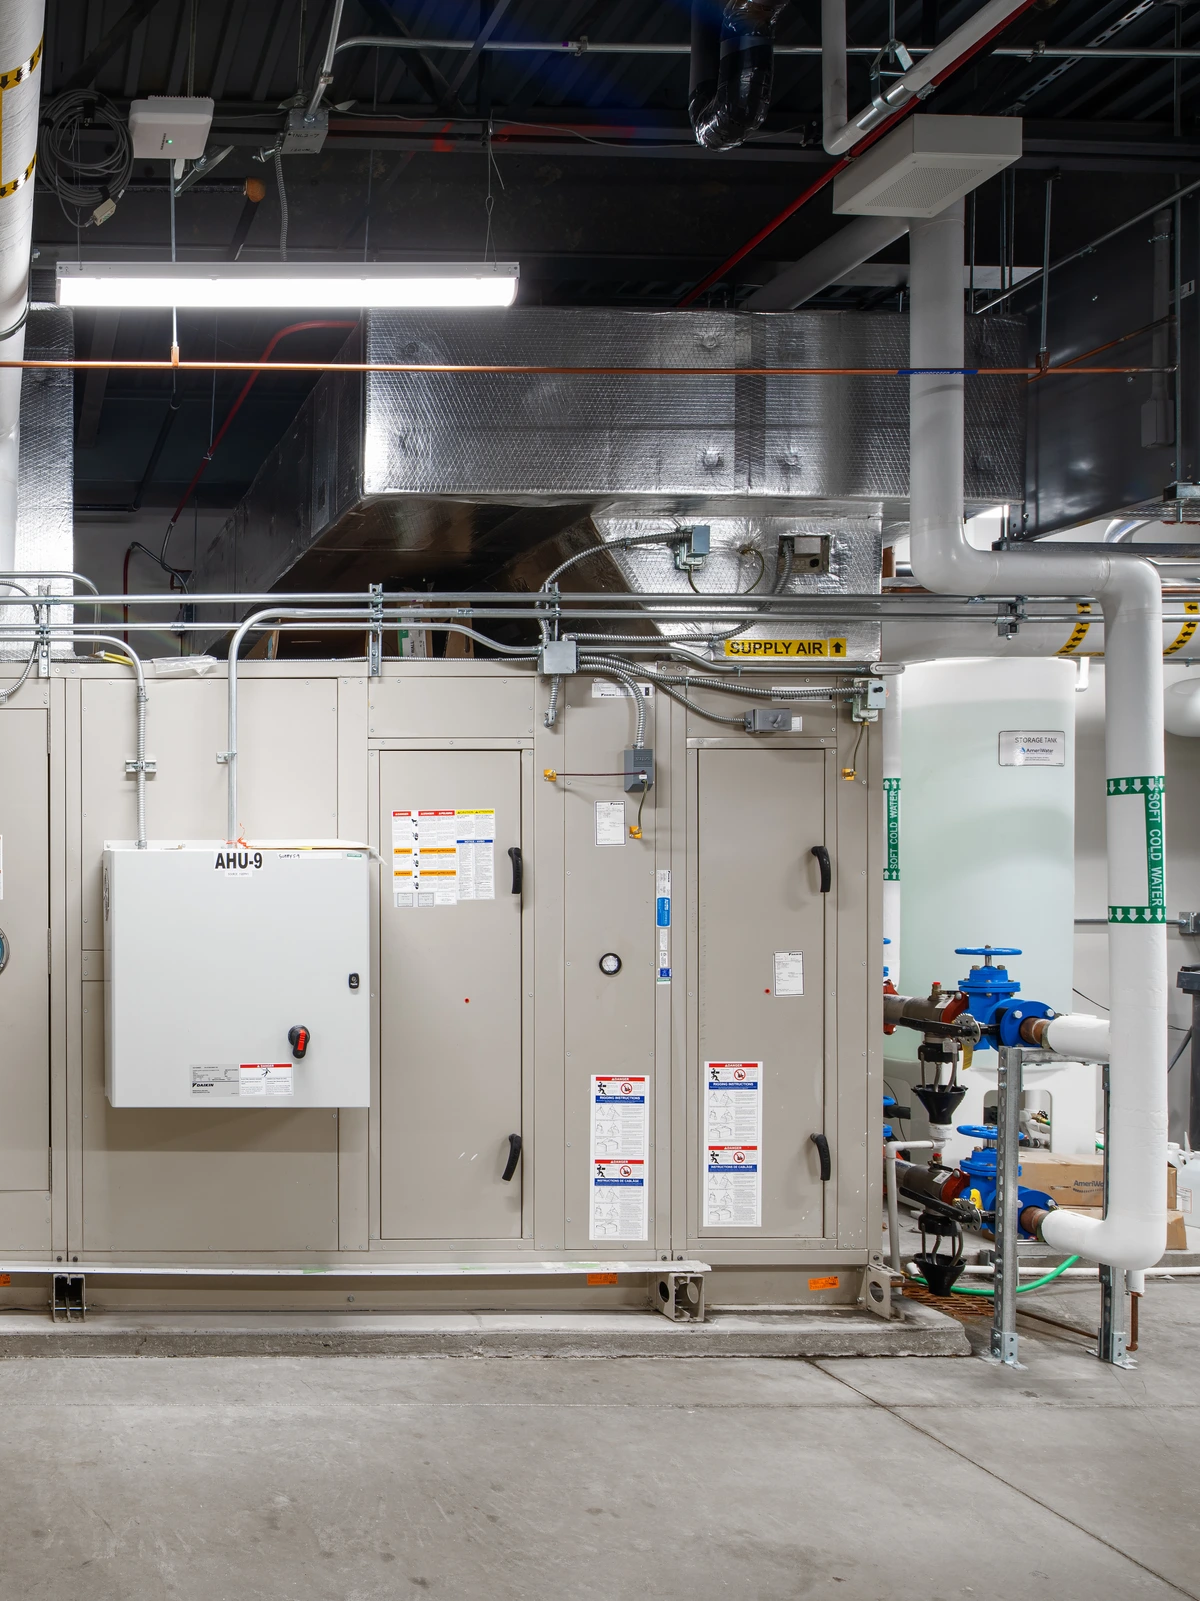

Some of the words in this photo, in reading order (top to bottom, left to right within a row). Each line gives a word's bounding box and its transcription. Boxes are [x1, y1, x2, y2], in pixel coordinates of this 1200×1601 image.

[730, 642, 792, 654] SUPPLY
[796, 642, 823, 654] AIR
[889, 790, 898, 818] WATER
[1148, 793, 1161, 823] SOFT
[889, 822, 898, 844] COLD
[1149, 829, 1162, 861] COLD
[214, 852, 263, 869] AHU-9
[889, 848, 898, 869] SOFT
[1151, 867, 1163, 906] WATER
